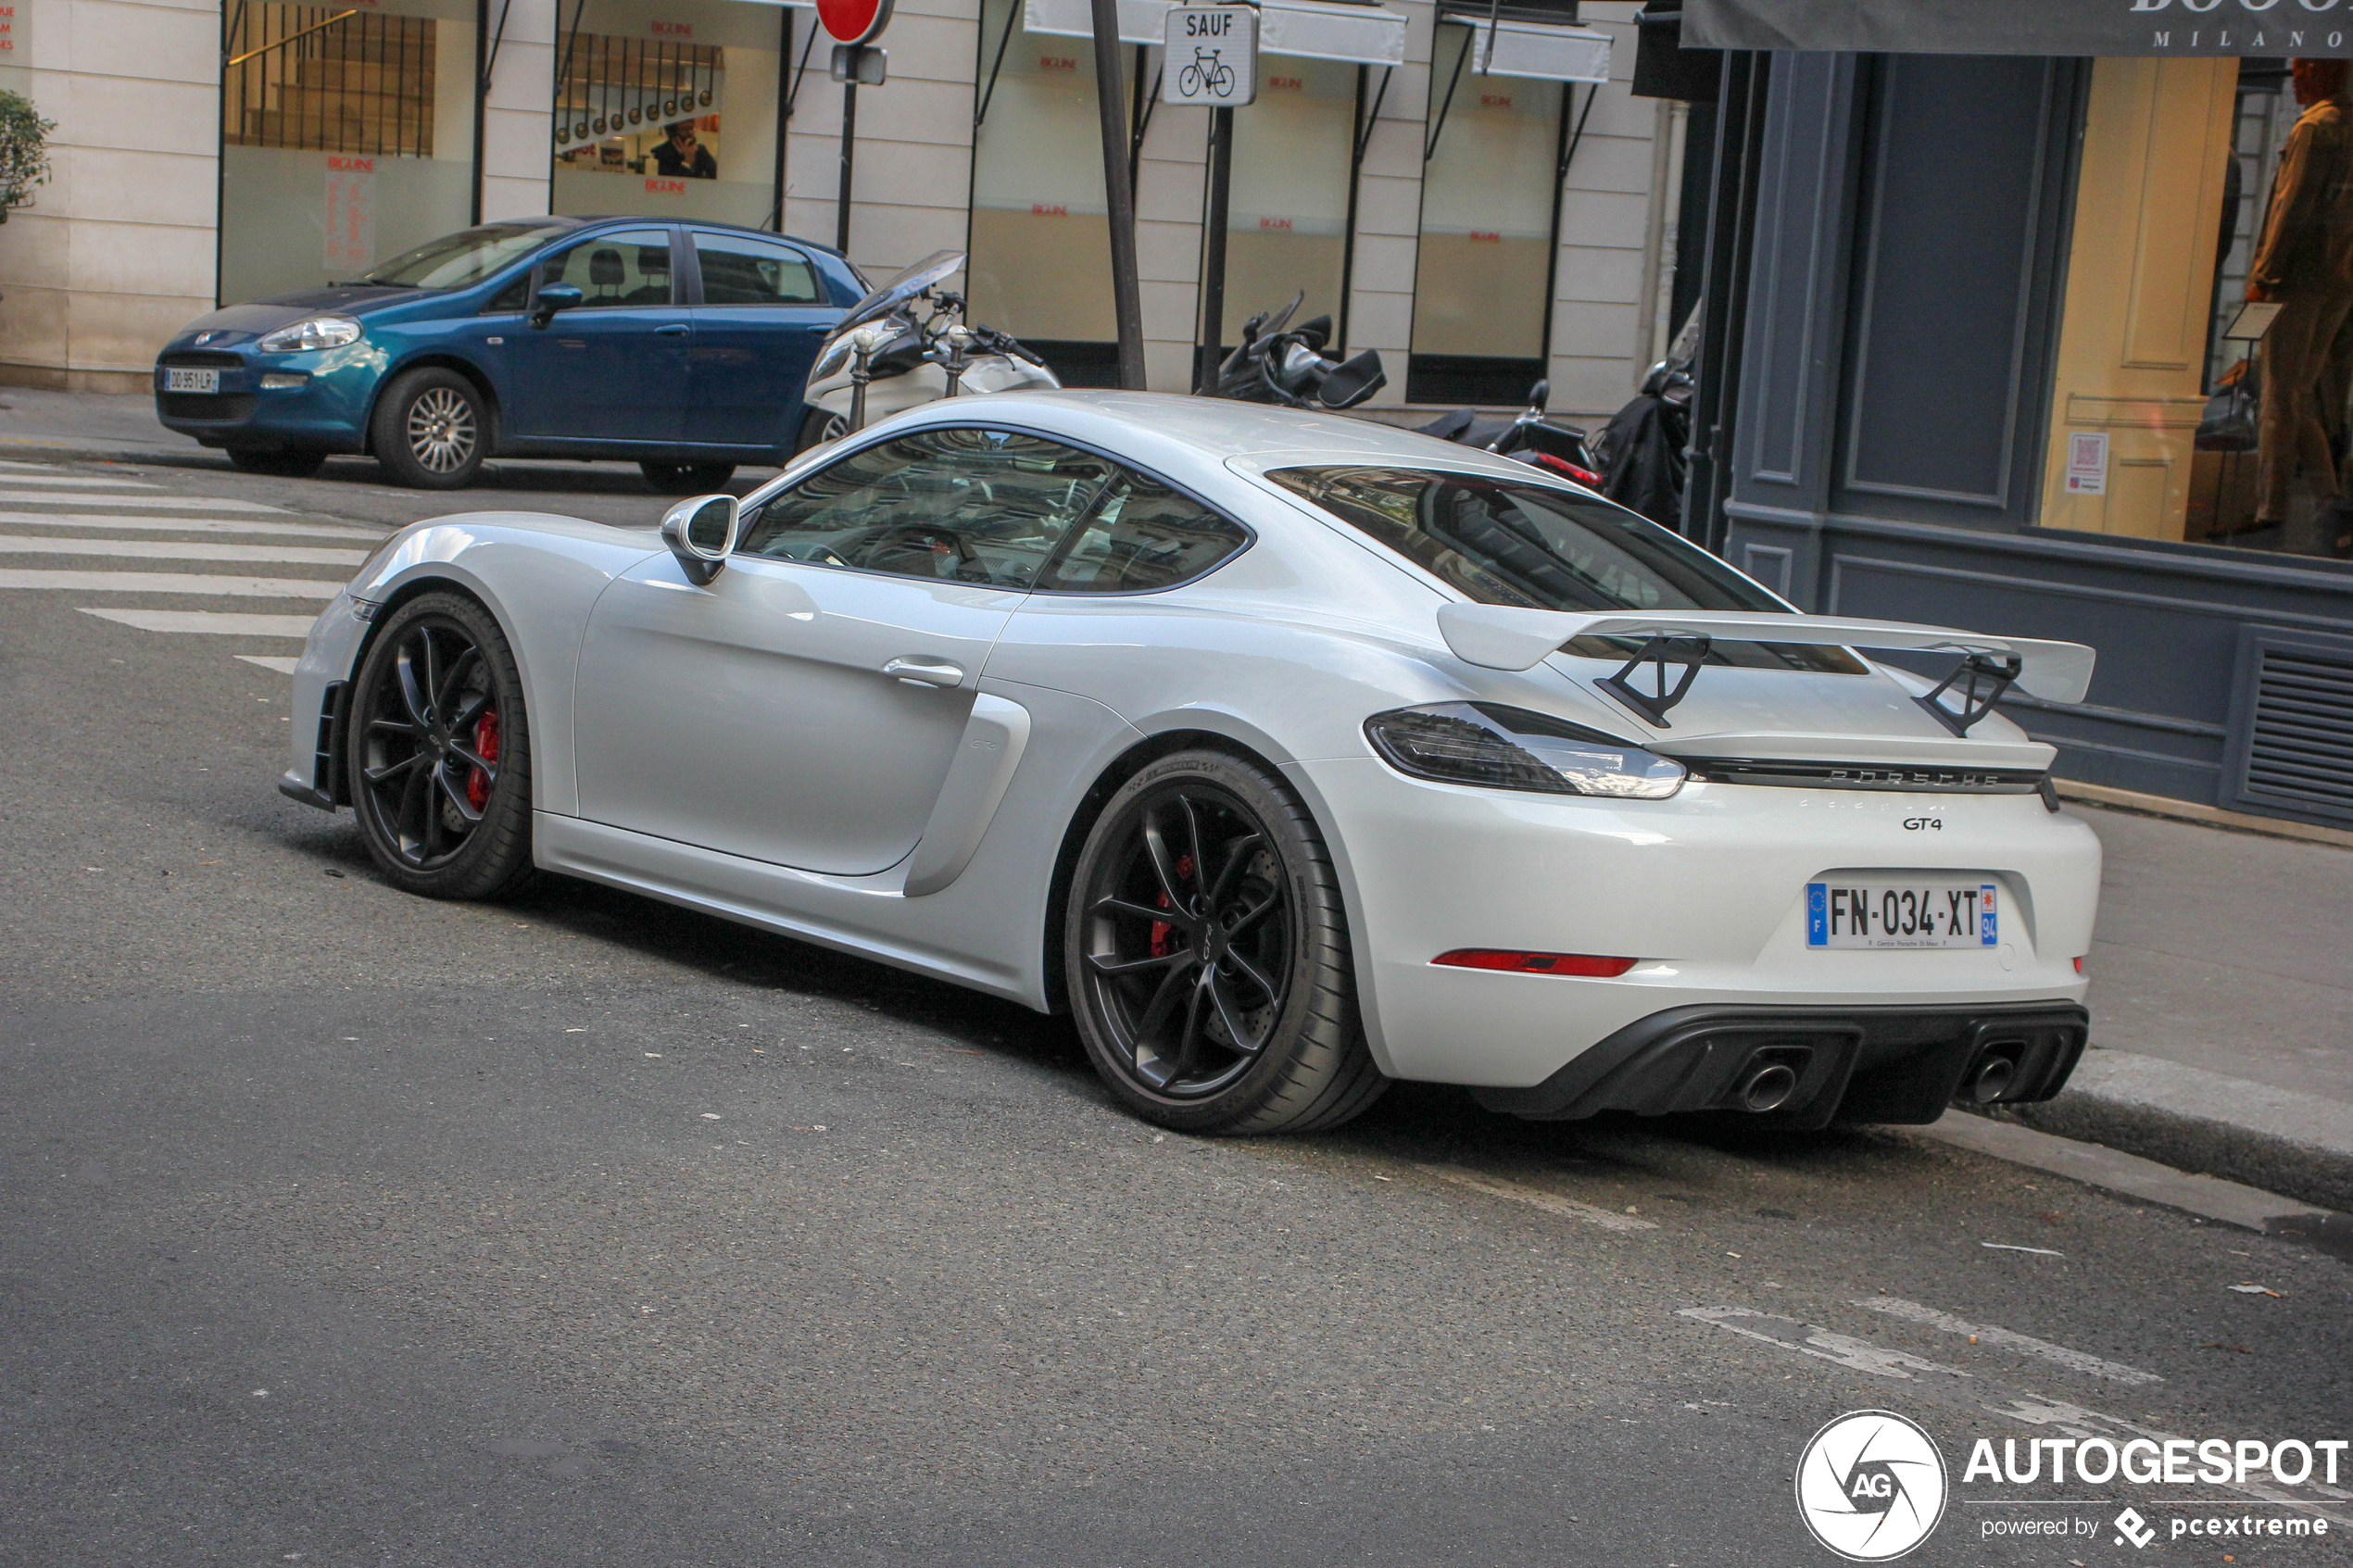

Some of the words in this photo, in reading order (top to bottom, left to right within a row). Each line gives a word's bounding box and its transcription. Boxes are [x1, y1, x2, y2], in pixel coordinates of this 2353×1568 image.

[1187, 13, 1232, 36] SAUF
[2153, 31, 2343, 46] MILANO
[1824, 770, 1998, 787] PORSCHE
[1903, 817, 1944, 831] GT4
[1831, 888, 1978, 936] FN-034-XT
[1814, 920, 1821, 933] F
[1982, 917, 1996, 938] 94
